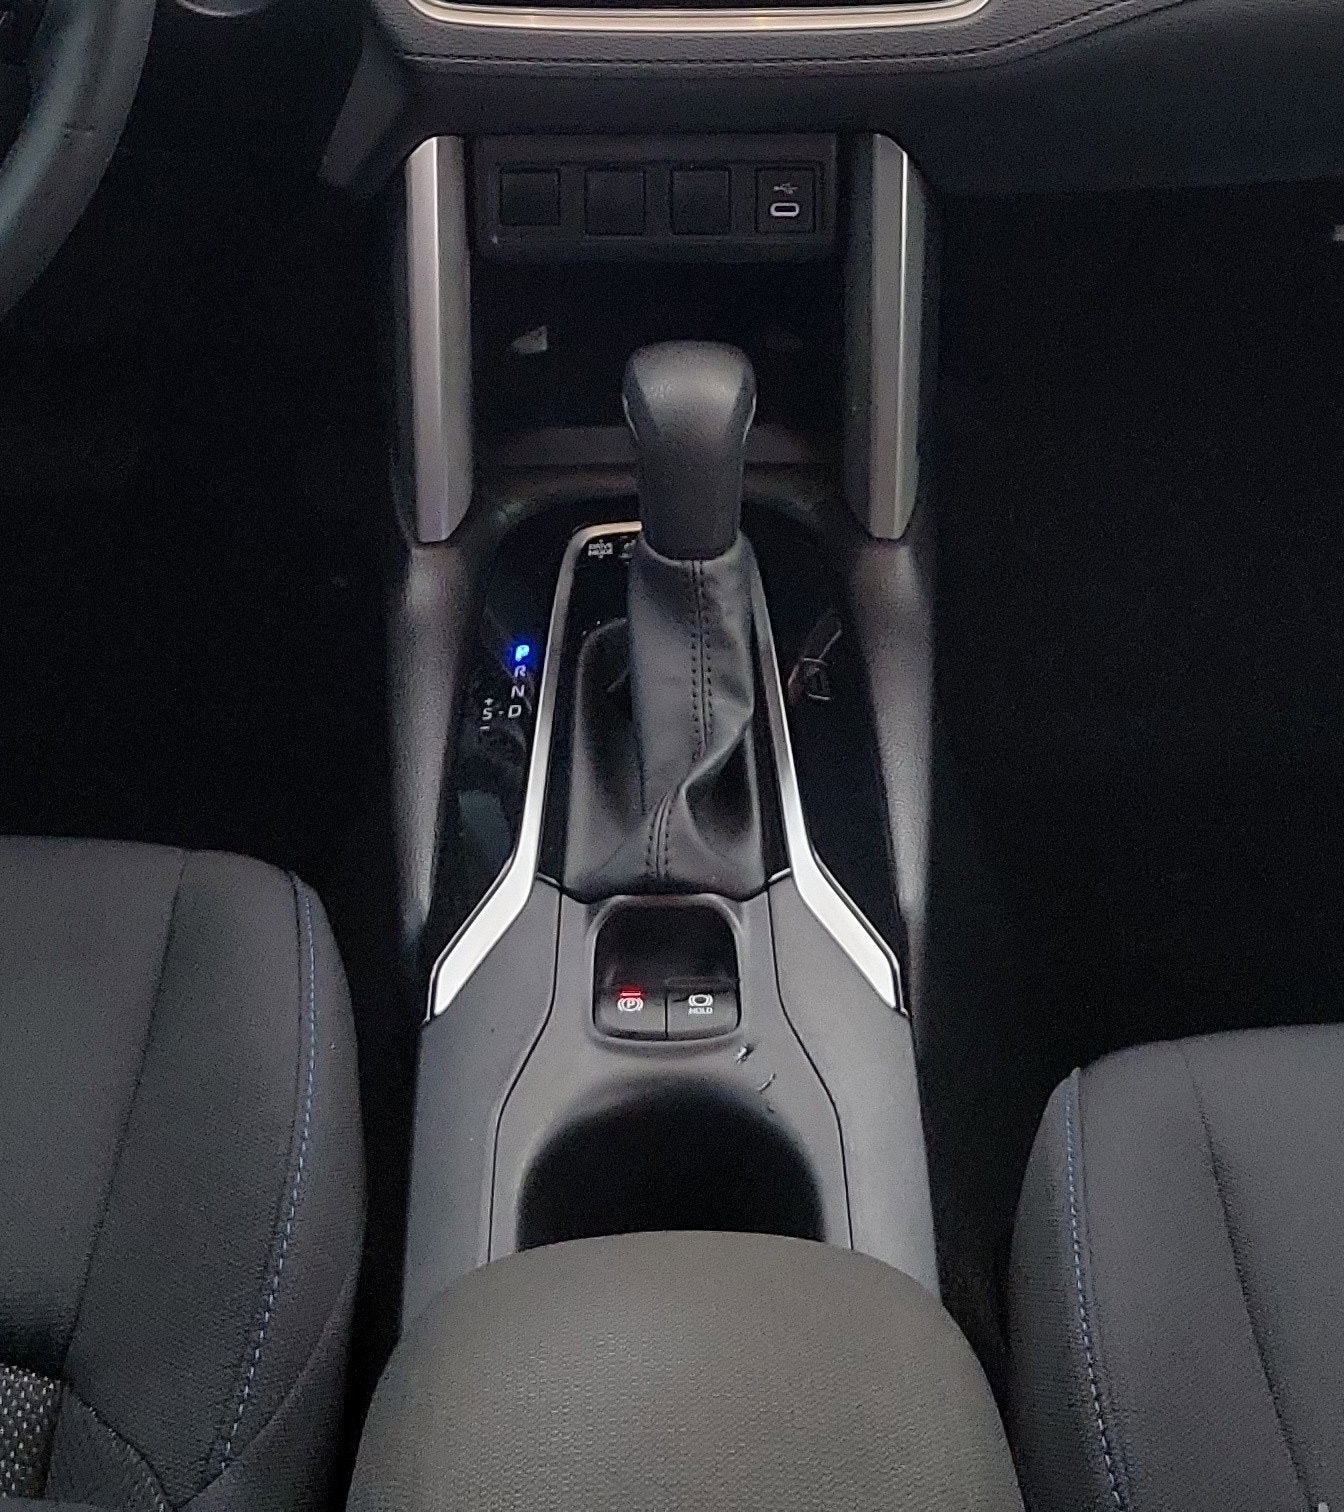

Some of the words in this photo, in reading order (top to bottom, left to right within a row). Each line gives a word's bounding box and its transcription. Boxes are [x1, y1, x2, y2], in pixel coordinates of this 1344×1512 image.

[515, 644, 530, 662] P
[514, 664, 527, 678] R
[510, 684, 525, 699] N
[507, 704, 522, 719] D
